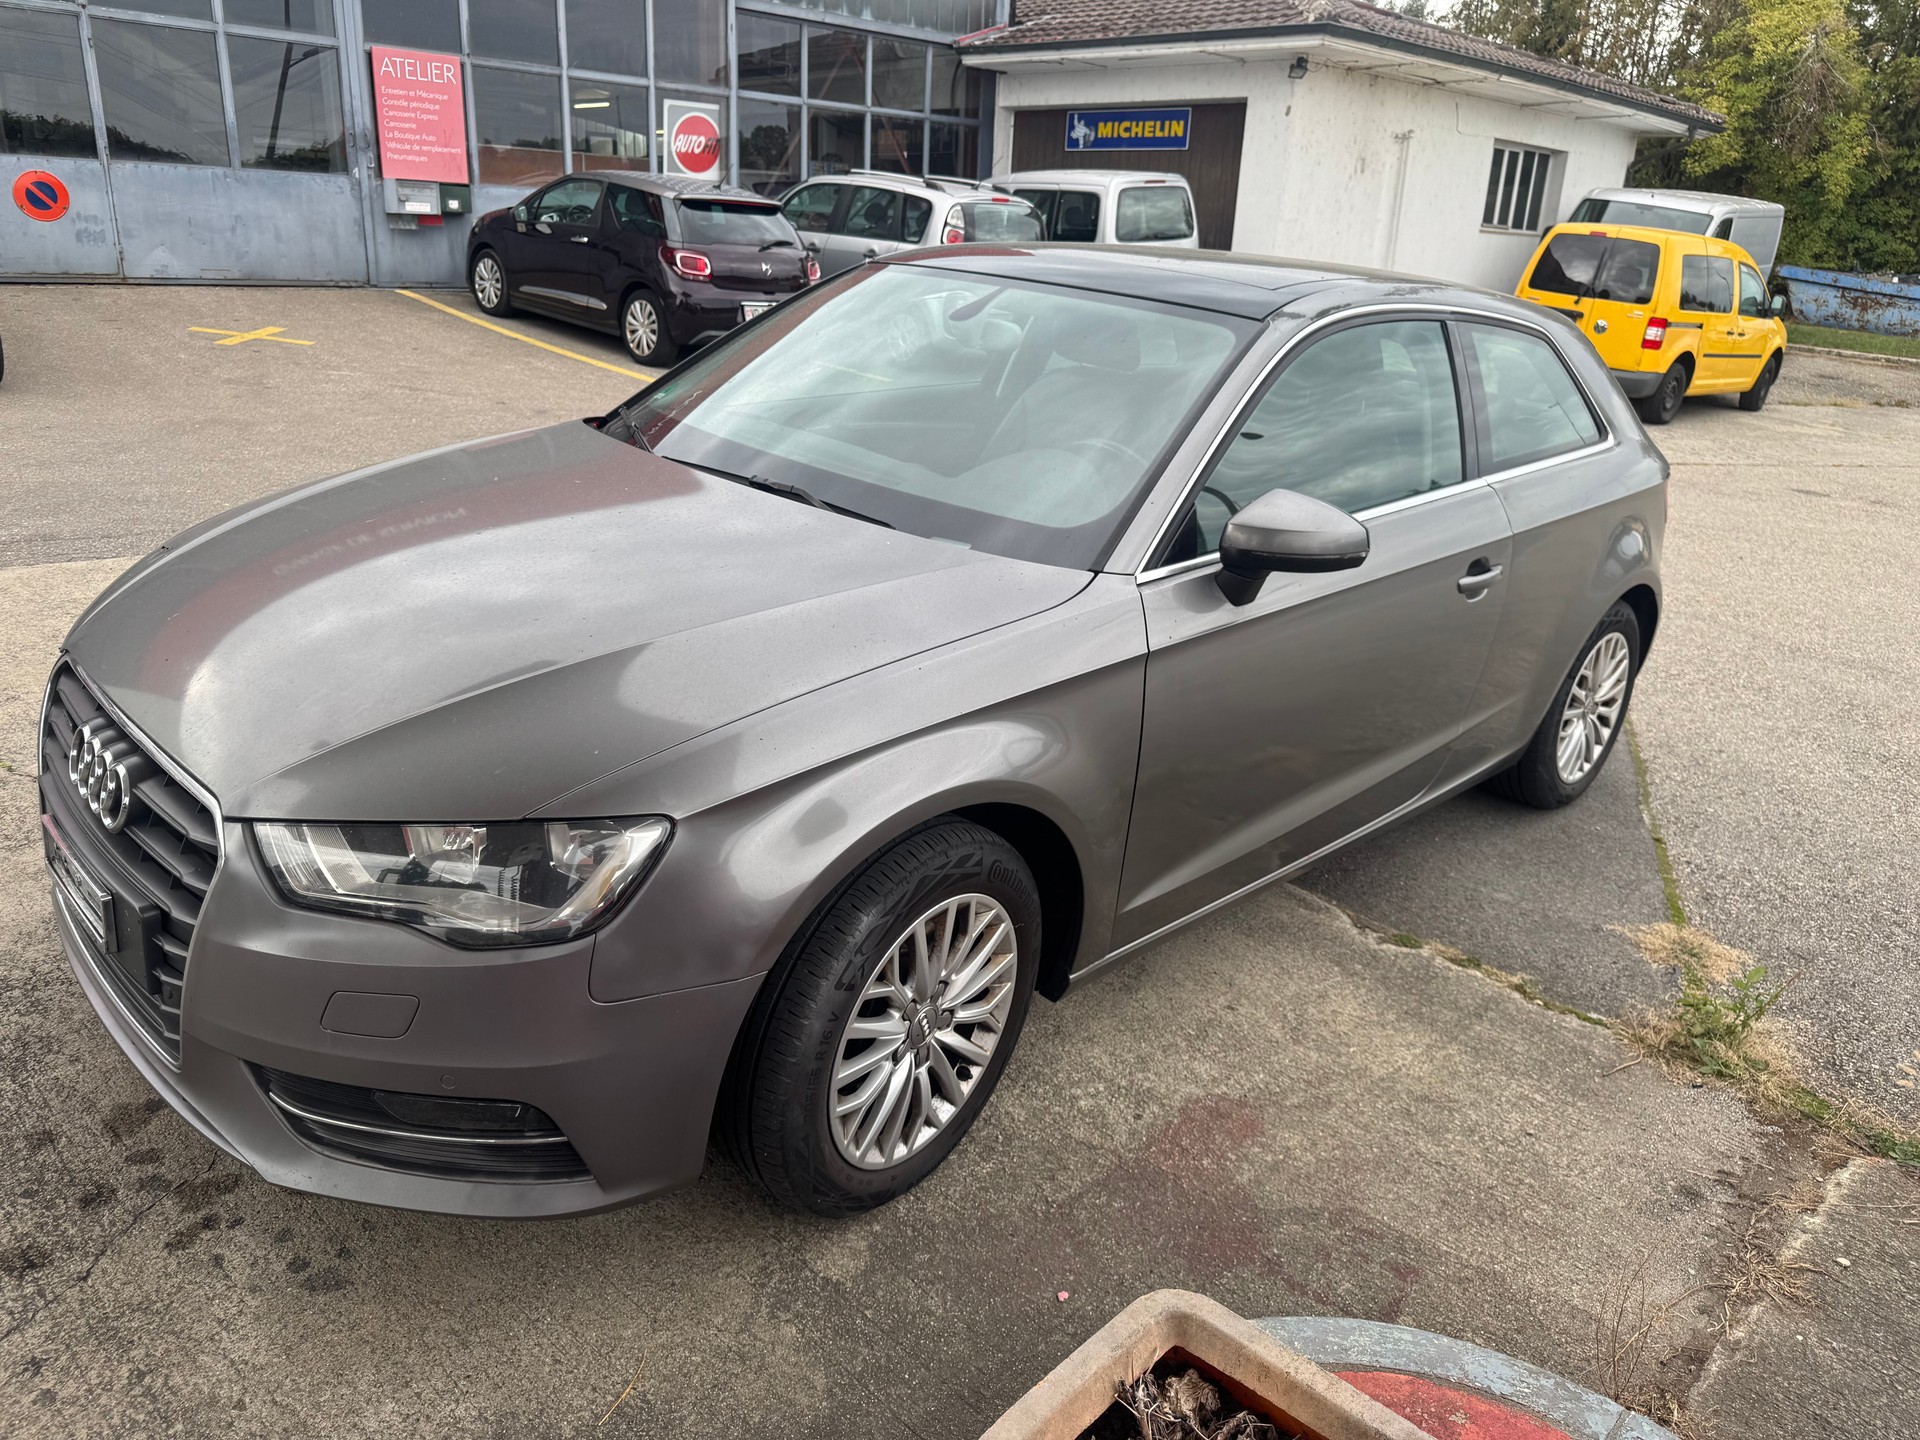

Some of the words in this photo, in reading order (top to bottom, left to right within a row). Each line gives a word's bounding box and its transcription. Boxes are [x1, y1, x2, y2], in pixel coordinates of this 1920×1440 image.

[379, 56, 457, 85] ATELIER
[381, 86, 409, 96] Entretien
[409, 89, 416, 97] et
[416, 89, 449, 101] Mécanique
[382, 97, 409, 107] Contrôle
[409, 99, 440, 111] périodique
[383, 108, 416, 119] Carrosserie
[417, 111, 439, 121] Express
[384, 119, 417, 129] Carrosserie
[1097, 120, 1185, 138] MICHELIN
[385, 130, 394, 138] La
[394, 131, 421, 141] Boutique
[421, 133, 437, 142] Auto
[385, 141, 412, 151] Véhicule
[413, 142, 421, 151] de
[421, 144, 461, 155] remplacement
[387, 152, 428, 163] Pneumatiques
[987, 859, 1040, 924] Continental
